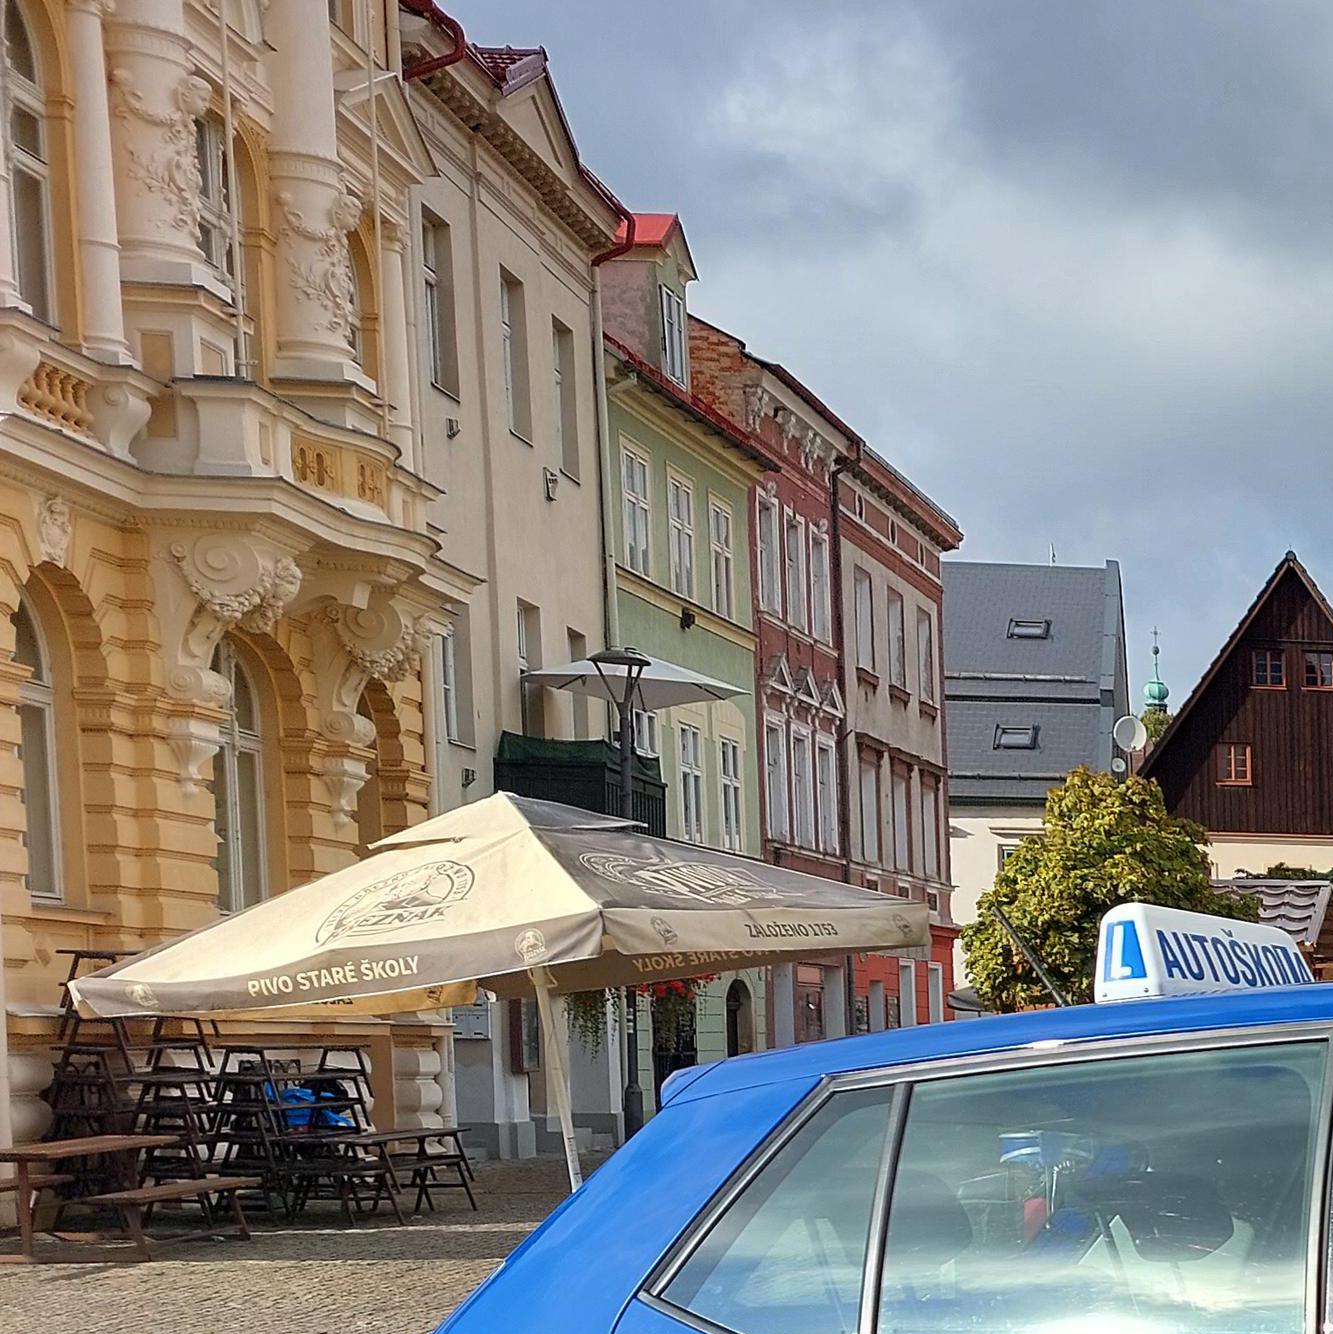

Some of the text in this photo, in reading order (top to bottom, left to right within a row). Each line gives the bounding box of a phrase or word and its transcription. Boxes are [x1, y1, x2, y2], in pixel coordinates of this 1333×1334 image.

[744, 920, 839, 939] ZALOŽENO 1753
[1110, 924, 1133, 980] L
[247, 955, 420, 998] PIVO STARÉ ŠKOLY
